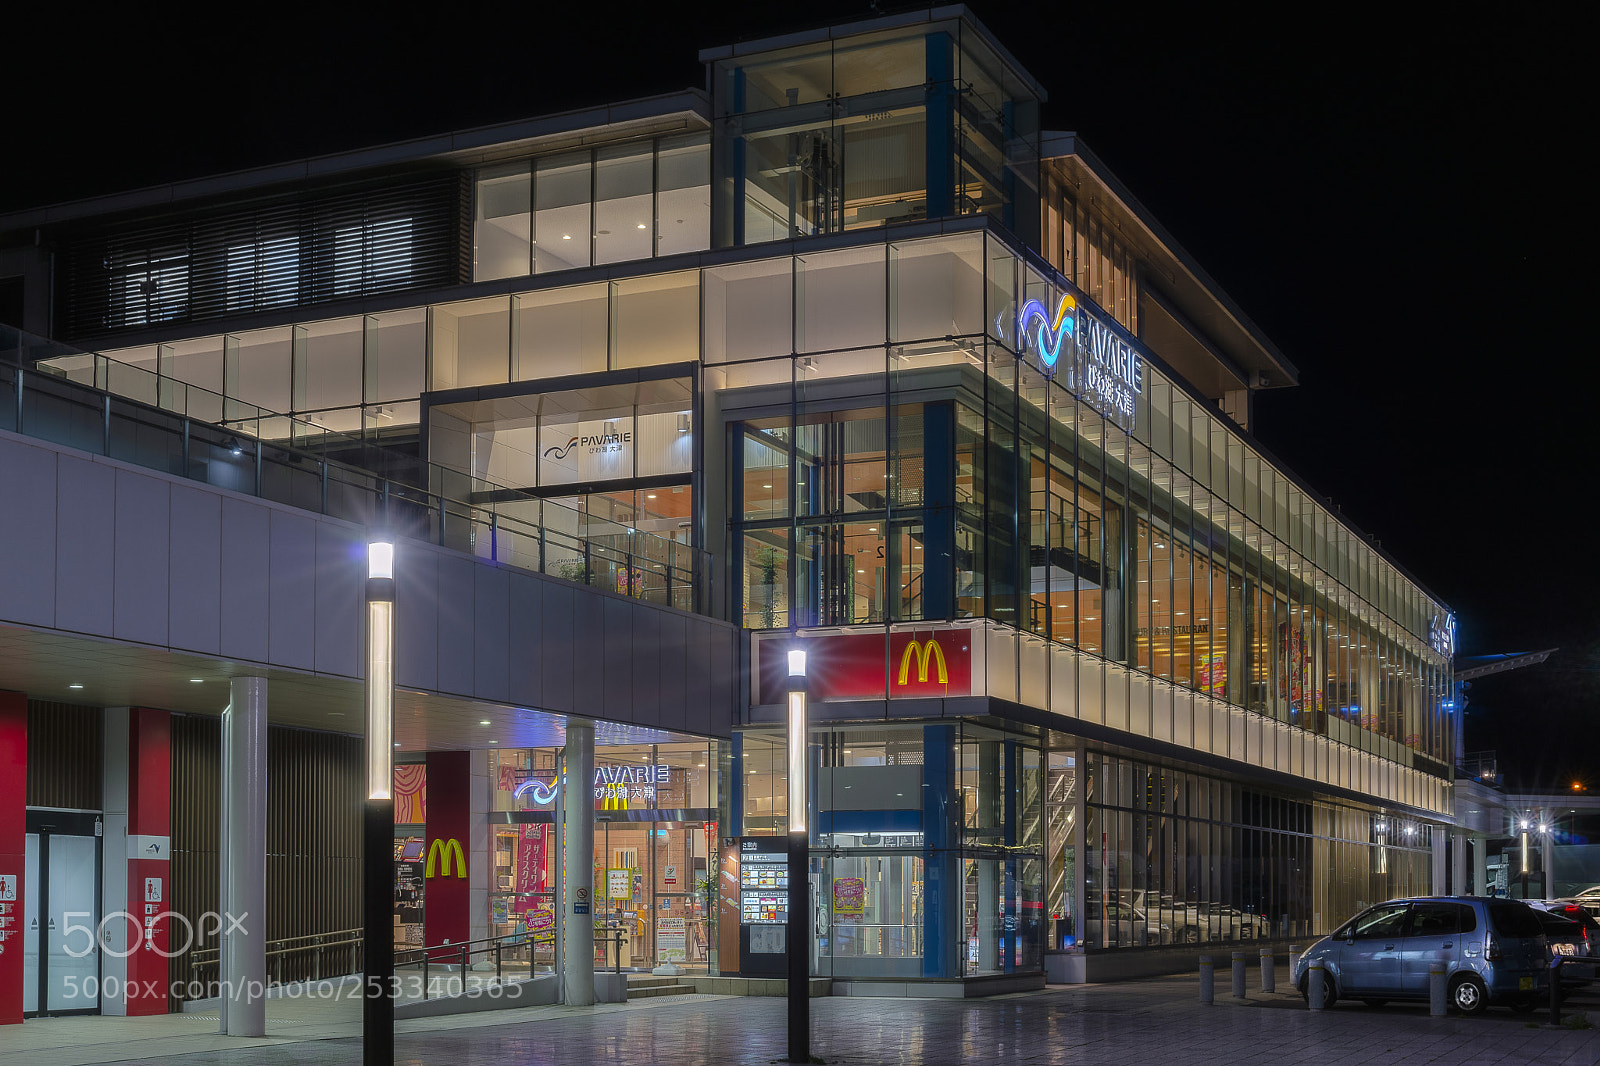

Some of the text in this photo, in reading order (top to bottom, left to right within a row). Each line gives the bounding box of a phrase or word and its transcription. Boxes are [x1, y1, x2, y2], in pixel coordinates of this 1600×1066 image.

[1076, 306, 1142, 394] PAVARIE
[581, 432, 630, 446] PAVARIE
[594, 764, 669, 785] AVARIE
